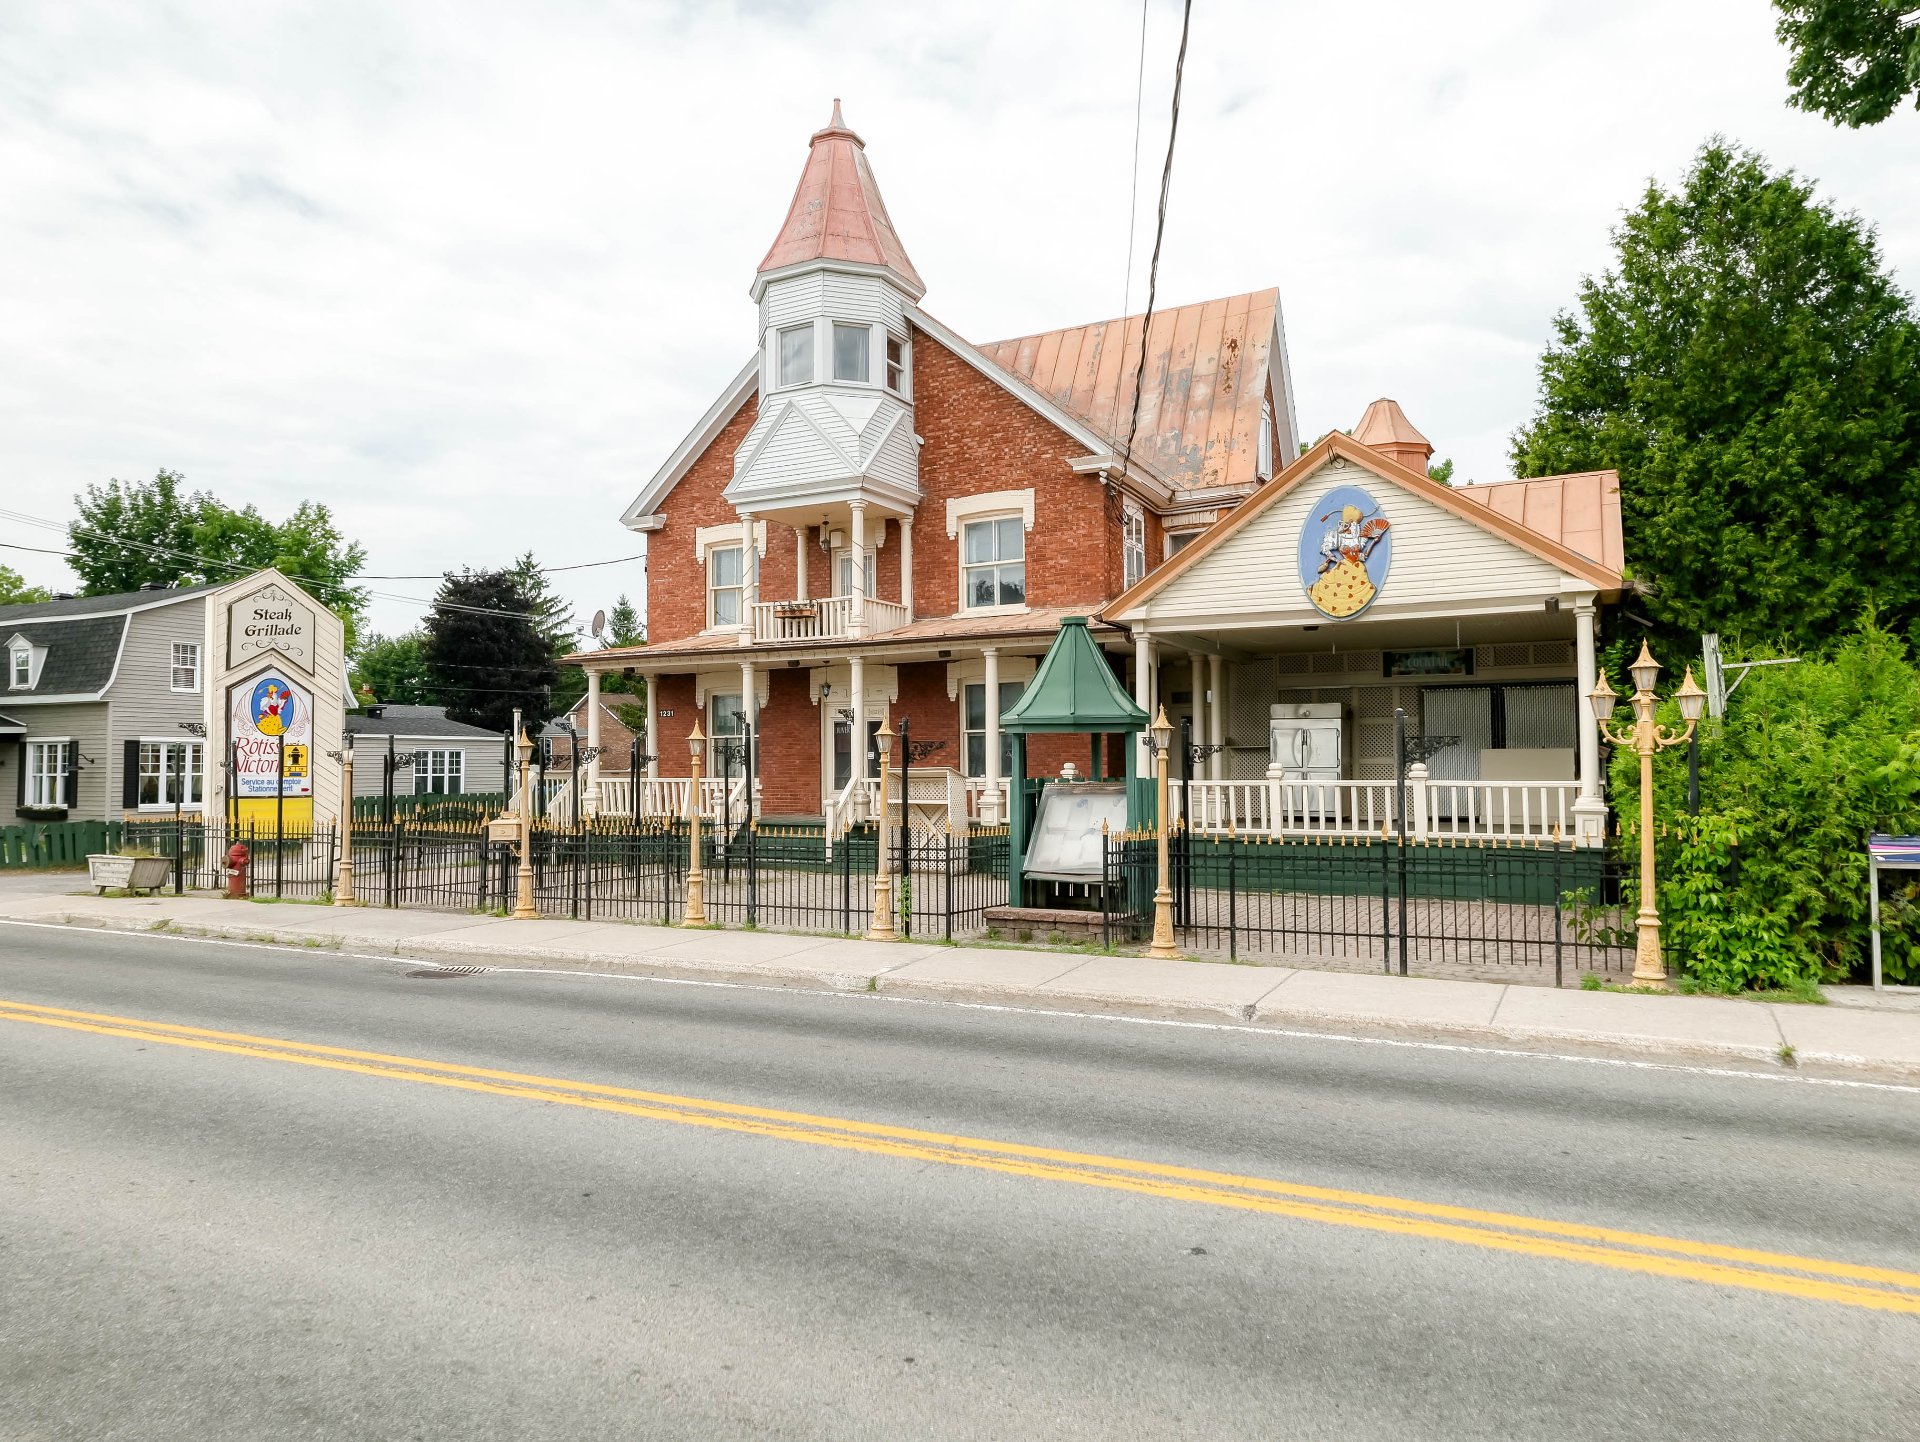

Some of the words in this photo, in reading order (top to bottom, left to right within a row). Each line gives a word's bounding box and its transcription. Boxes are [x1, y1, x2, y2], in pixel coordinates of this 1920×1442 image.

[252, 608, 292, 622] Steak
[244, 624, 302, 637] Grillade
[1407, 655, 1449, 667] COCKTAIL
[241, 778, 265, 786] Service
[277, 778, 302, 786] cmptoir
